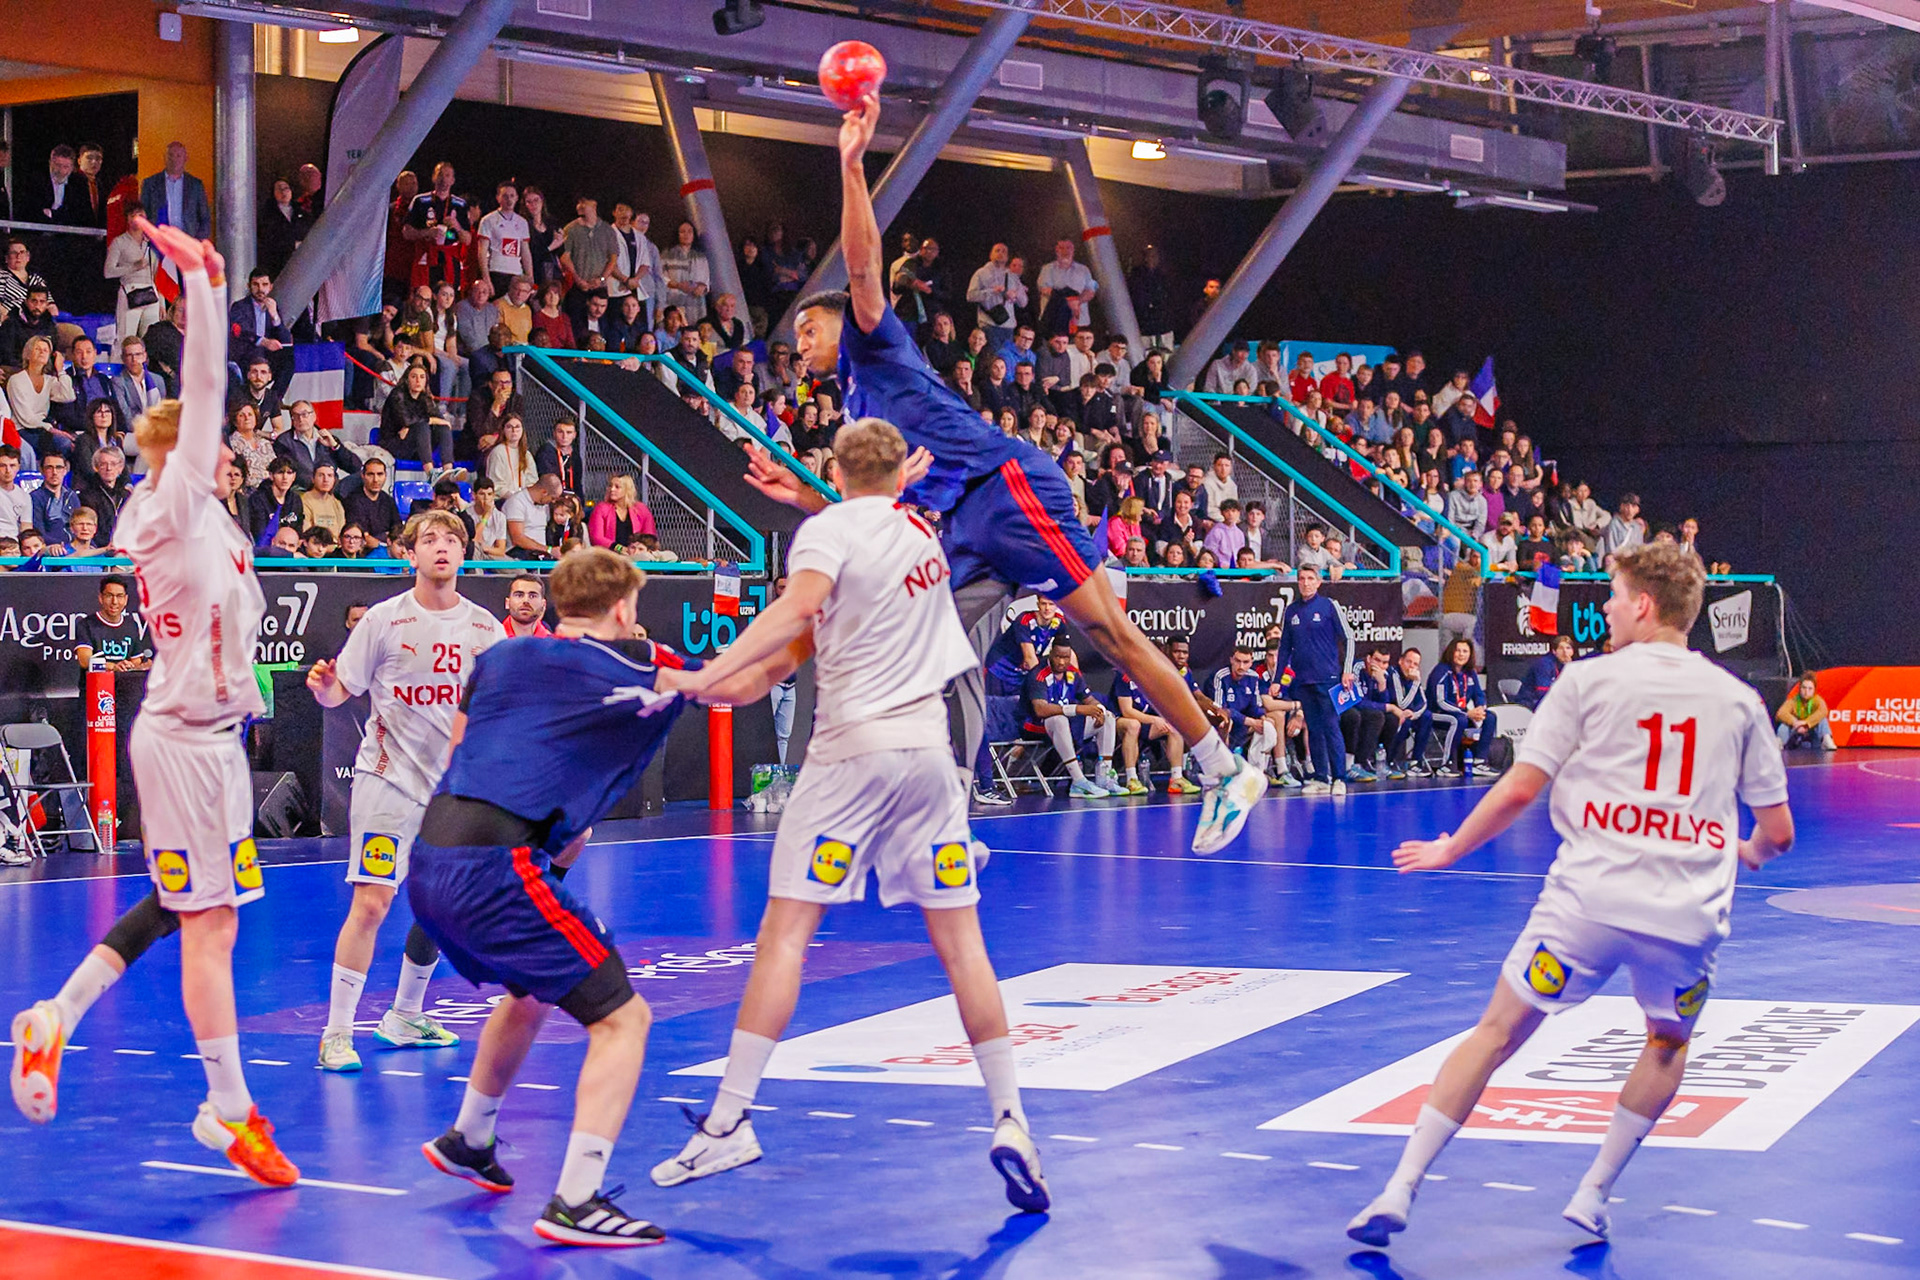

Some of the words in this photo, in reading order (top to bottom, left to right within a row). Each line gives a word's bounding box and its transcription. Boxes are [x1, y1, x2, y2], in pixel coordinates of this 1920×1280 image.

[1127, 605, 1201, 635] gencity
[1713, 606, 1747, 629] Serris
[432, 643, 462, 674] 25
[1829, 709, 1852, 722] DE
[1637, 712, 1696, 796] 11
[1583, 801, 1725, 850] NORLYS
